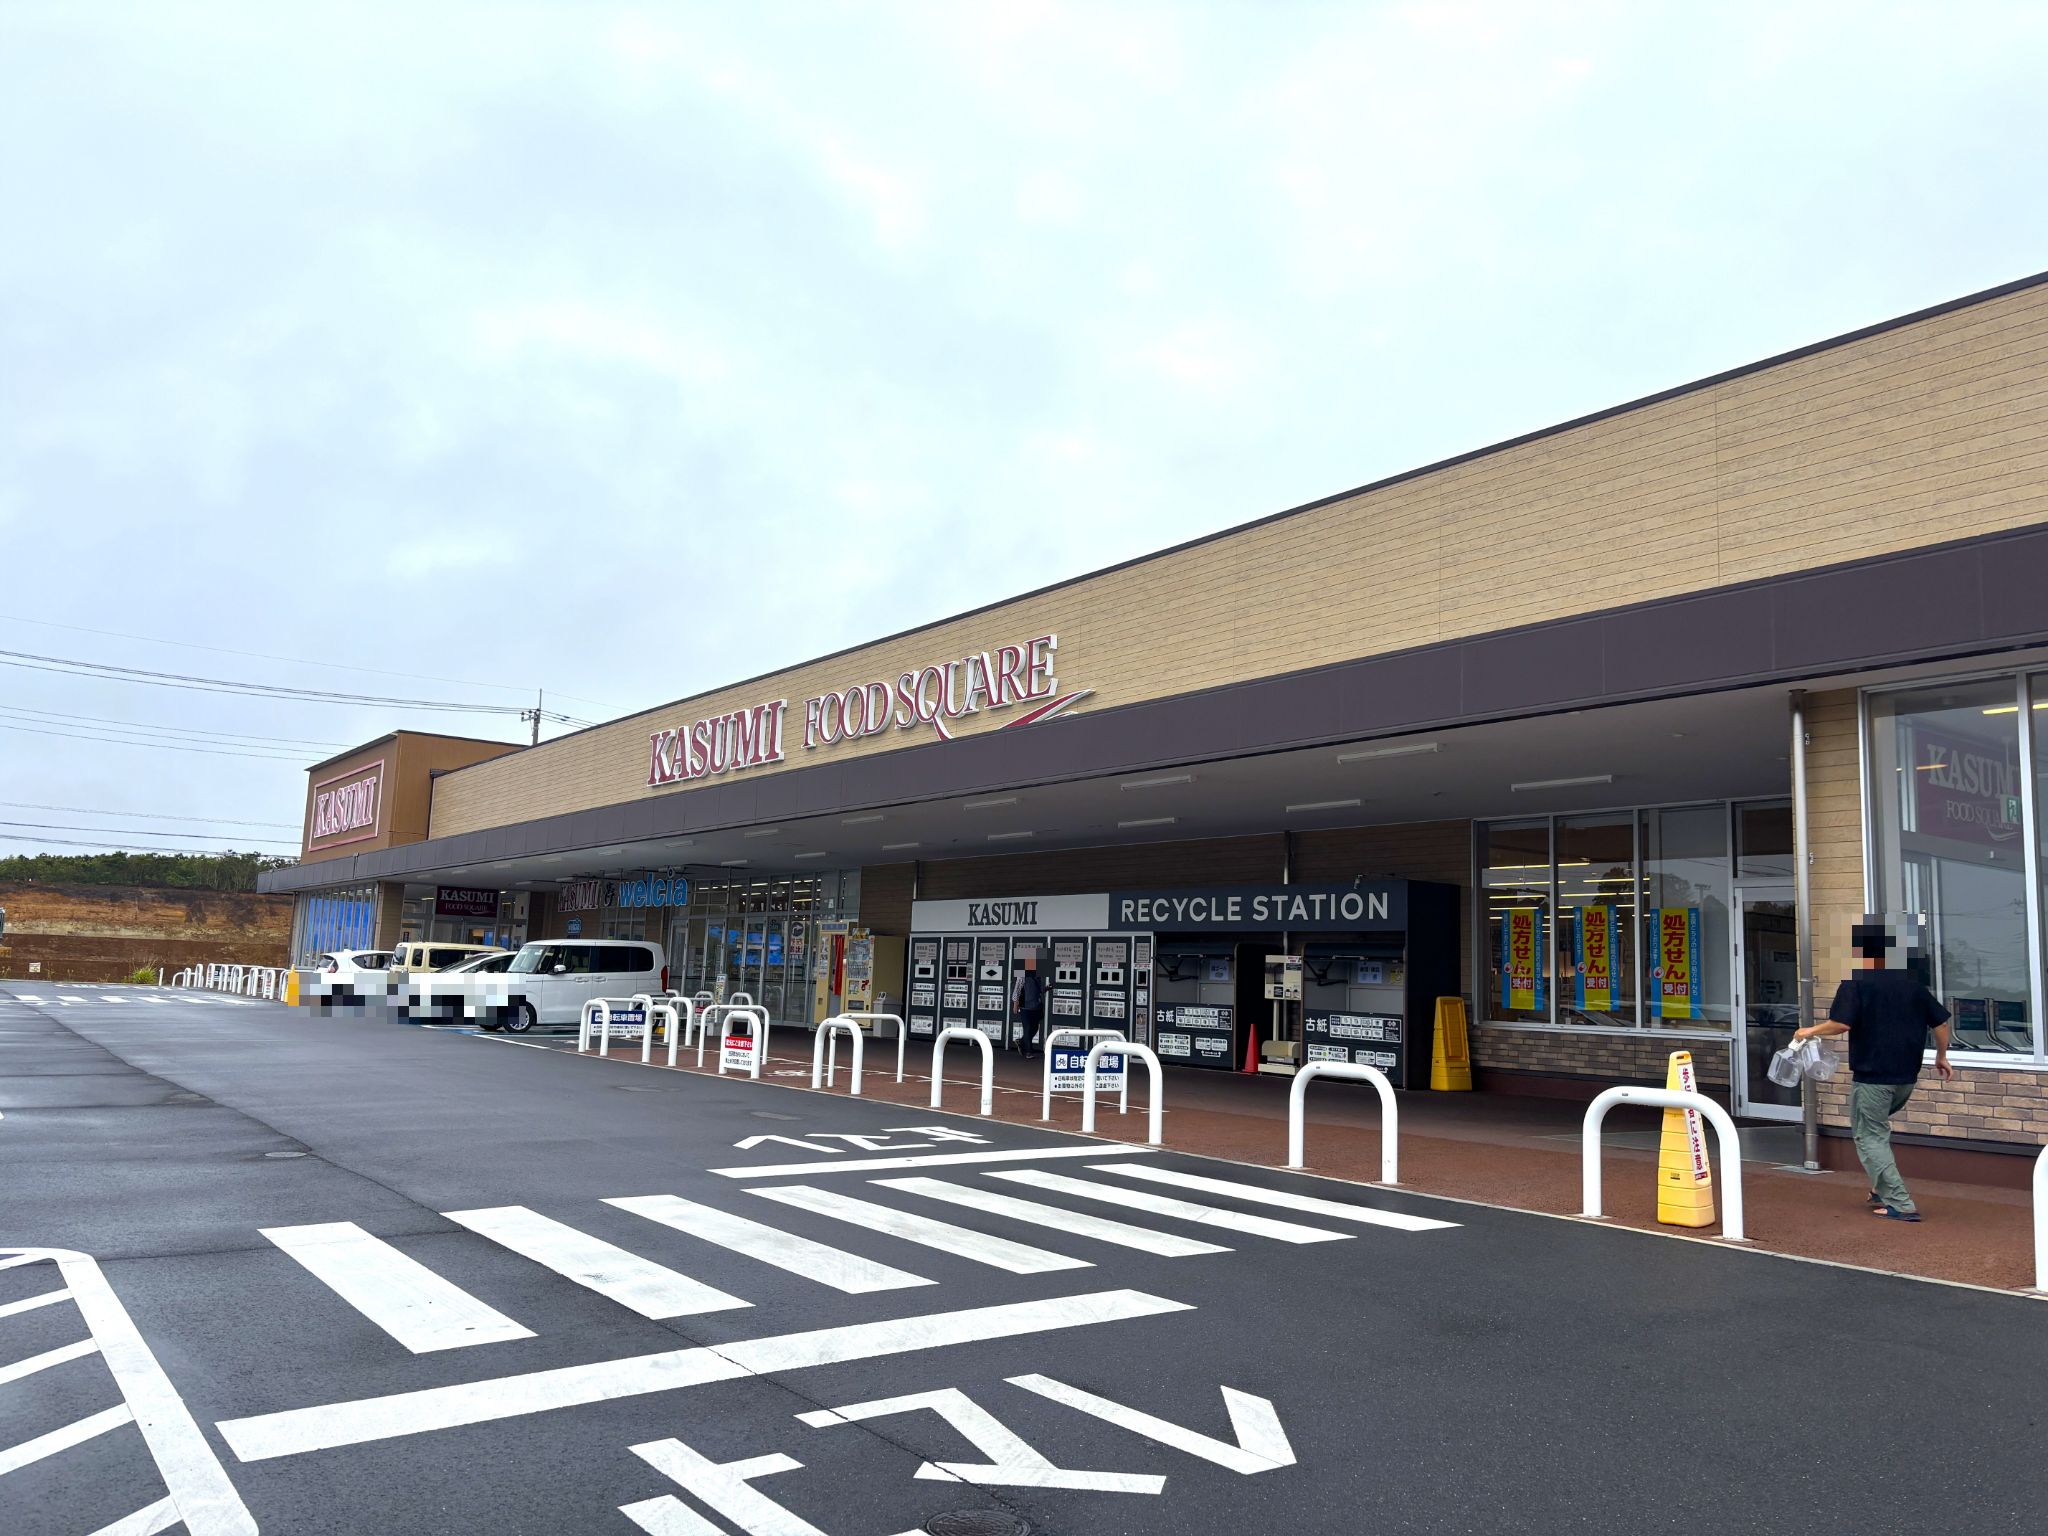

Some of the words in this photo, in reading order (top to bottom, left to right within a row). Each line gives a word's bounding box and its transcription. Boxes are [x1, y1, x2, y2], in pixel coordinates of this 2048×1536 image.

[646, 699, 788, 787] KASUMI
[802, 681, 894, 750] FOOD
[895, 634, 1060, 742] SQUARE
[1927, 743, 2018, 799] KASUM
[314, 776, 377, 839] KASUMI
[440, 889, 495, 903] KASUMI
[618, 870, 688, 908] welcia
[968, 901, 1038, 926] KASUMI
[1121, 897, 1241, 922] RECYCLE
[1252, 892, 1388, 921] STATION
[1512, 914, 1532, 975] 処方せん
[1585, 911, 1606, 974] 処方せん
[1663, 914, 1686, 980] 処方せん
[1512, 978, 1533, 989] 受付
[1586, 977, 1608, 989] 受付
[1663, 983, 1688, 995] 受付
[1157, 1010, 1175, 1023] 古紙
[1305, 1018, 1328, 1033] 古紙
[1069, 1055, 1119, 1069] 自転置場
